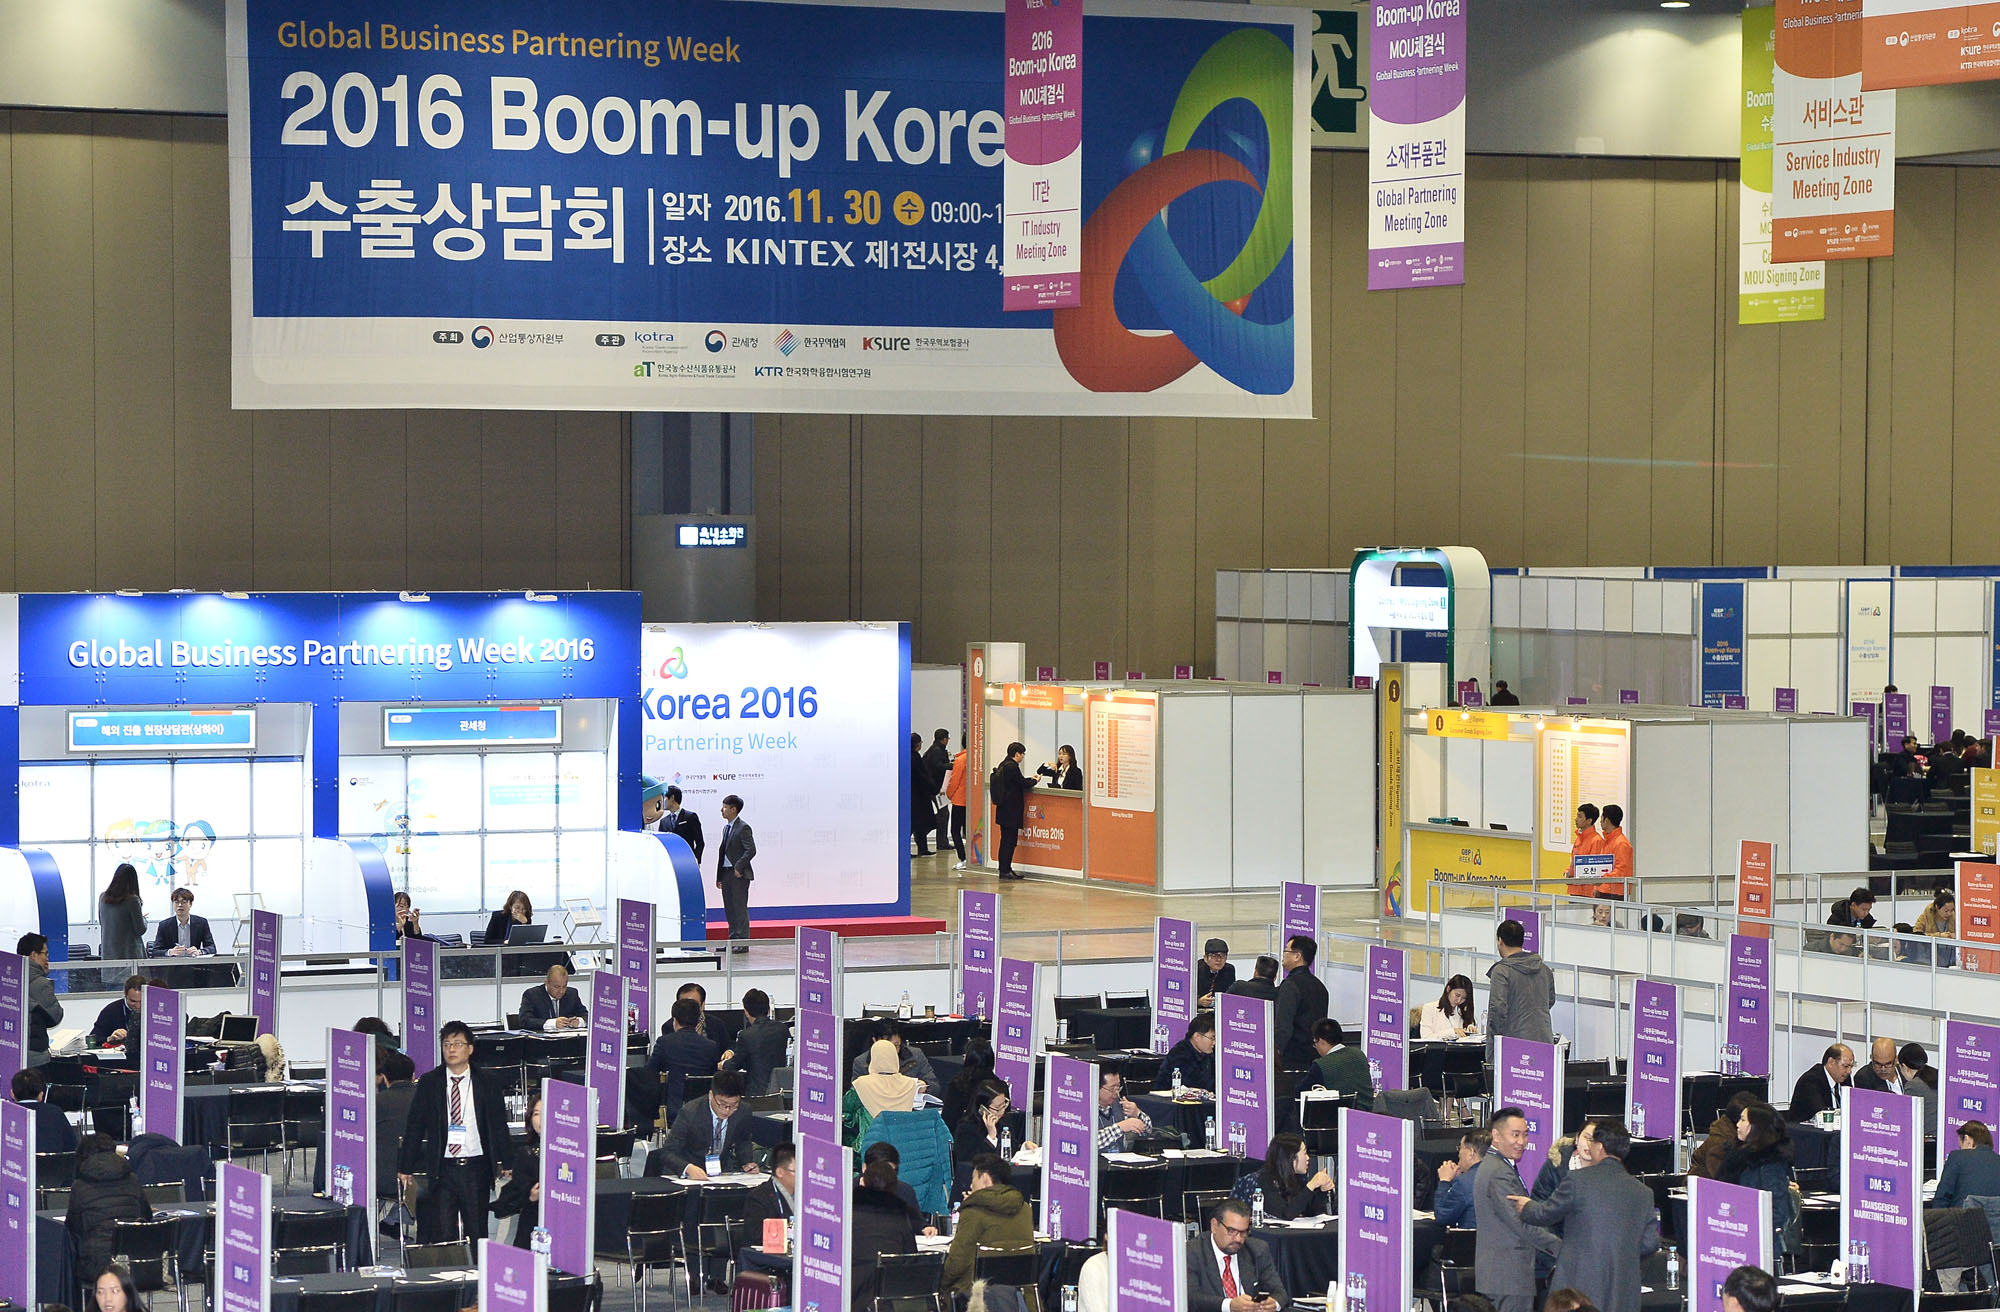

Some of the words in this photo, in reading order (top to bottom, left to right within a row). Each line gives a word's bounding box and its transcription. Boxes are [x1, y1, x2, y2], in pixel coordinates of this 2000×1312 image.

[1376, 4, 1424, 27] Boom-up
[1426, 0, 1460, 20] Korea
[1783, 15, 1804, 29] Global
[1804, 13, 1833, 27] Business
[1834, 9, 1863, 23] Partnerin
[278, 21, 371, 49] Global
[381, 25, 505, 53] Business
[512, 29, 660, 67] Partnering
[666, 35, 742, 63] Week
[1032, 30, 1053, 51] 2016
[1389, 32, 1445, 60] MOU체결식
[1009, 57, 1047, 78] Boom-up
[1049, 53, 1076, 72] Korea
[1376, 69, 1392, 81] Global
[1393, 67, 1415, 79] Business
[1443, 61, 1459, 73] Week
[1803, 95, 1864, 130] 서비스관
[281, 71, 464, 151] 2016
[491, 76, 819, 178] Boom-up
[845, 88, 1004, 166] Kore
[1386, 139, 1447, 169] 소재부품관
[1786, 150, 1829, 171] Service
[1833, 146, 1880, 168] Industry
[1032, 179, 1050, 203] IT관
[1377, 187, 1405, 207] Global
[1408, 184, 1457, 205] Partnering
[1793, 178, 1840, 201] Meeting
[1843, 175, 1873, 195] Zone
[662, 192, 711, 222] 일자
[844, 190, 881, 225] 30
[931, 201, 1003, 224] 09:00~1
[282, 180, 625, 265] 수출상담회
[1022, 221, 1029, 236] IT
[1031, 220, 1061, 238] Industry
[1385, 213, 1422, 234] Meeting
[1425, 211, 1448, 229] Zone
[662, 236, 712, 266] 장소
[727, 238, 855, 267] KINTEX
[865, 239, 977, 271] 제1전시장
[985, 243, 1004, 275] 4,
[1016, 243, 1046, 262] Meeting
[1048, 242, 1067, 258] Zone
[1744, 269, 1765, 285] MOU
[1766, 268, 1798, 287] Signing
[1800, 267, 1820, 282] Zone
[499, 333, 564, 345] 산업통상자원부
[634, 331, 674, 343] kotra
[731, 336, 759, 348] 관세청
[803, 337, 847, 349] 한국무역협회
[915, 337, 970, 348] 한국무역보험공사
[755, 366, 783, 377] KTR
[786, 367, 871, 378] 한국화학융합시험연구원
[68, 640, 164, 669] Global
[171, 640, 297, 667] Business
[303, 637, 454, 671] Partnering
[457, 636, 535, 665] Week
[539, 637, 595, 663] 2016
[641, 687, 730, 720] Korea
[740, 686, 818, 718] 2016
[645, 733, 743, 755] Partnering
[748, 731, 797, 750] Week
[1032, 826, 1050, 839] Korea
[1050, 827, 1064, 841] 2016
[1741, 998, 1756, 1009] DM-47
[1647, 1053, 1662, 1065] DM-41
[1235, 1068, 1251, 1081] DM-34
[1963, 1098, 1982, 1111] DM-42
[1869, 1178, 1891, 1192] DM-36
[1364, 1205, 1384, 1221] DM-29
